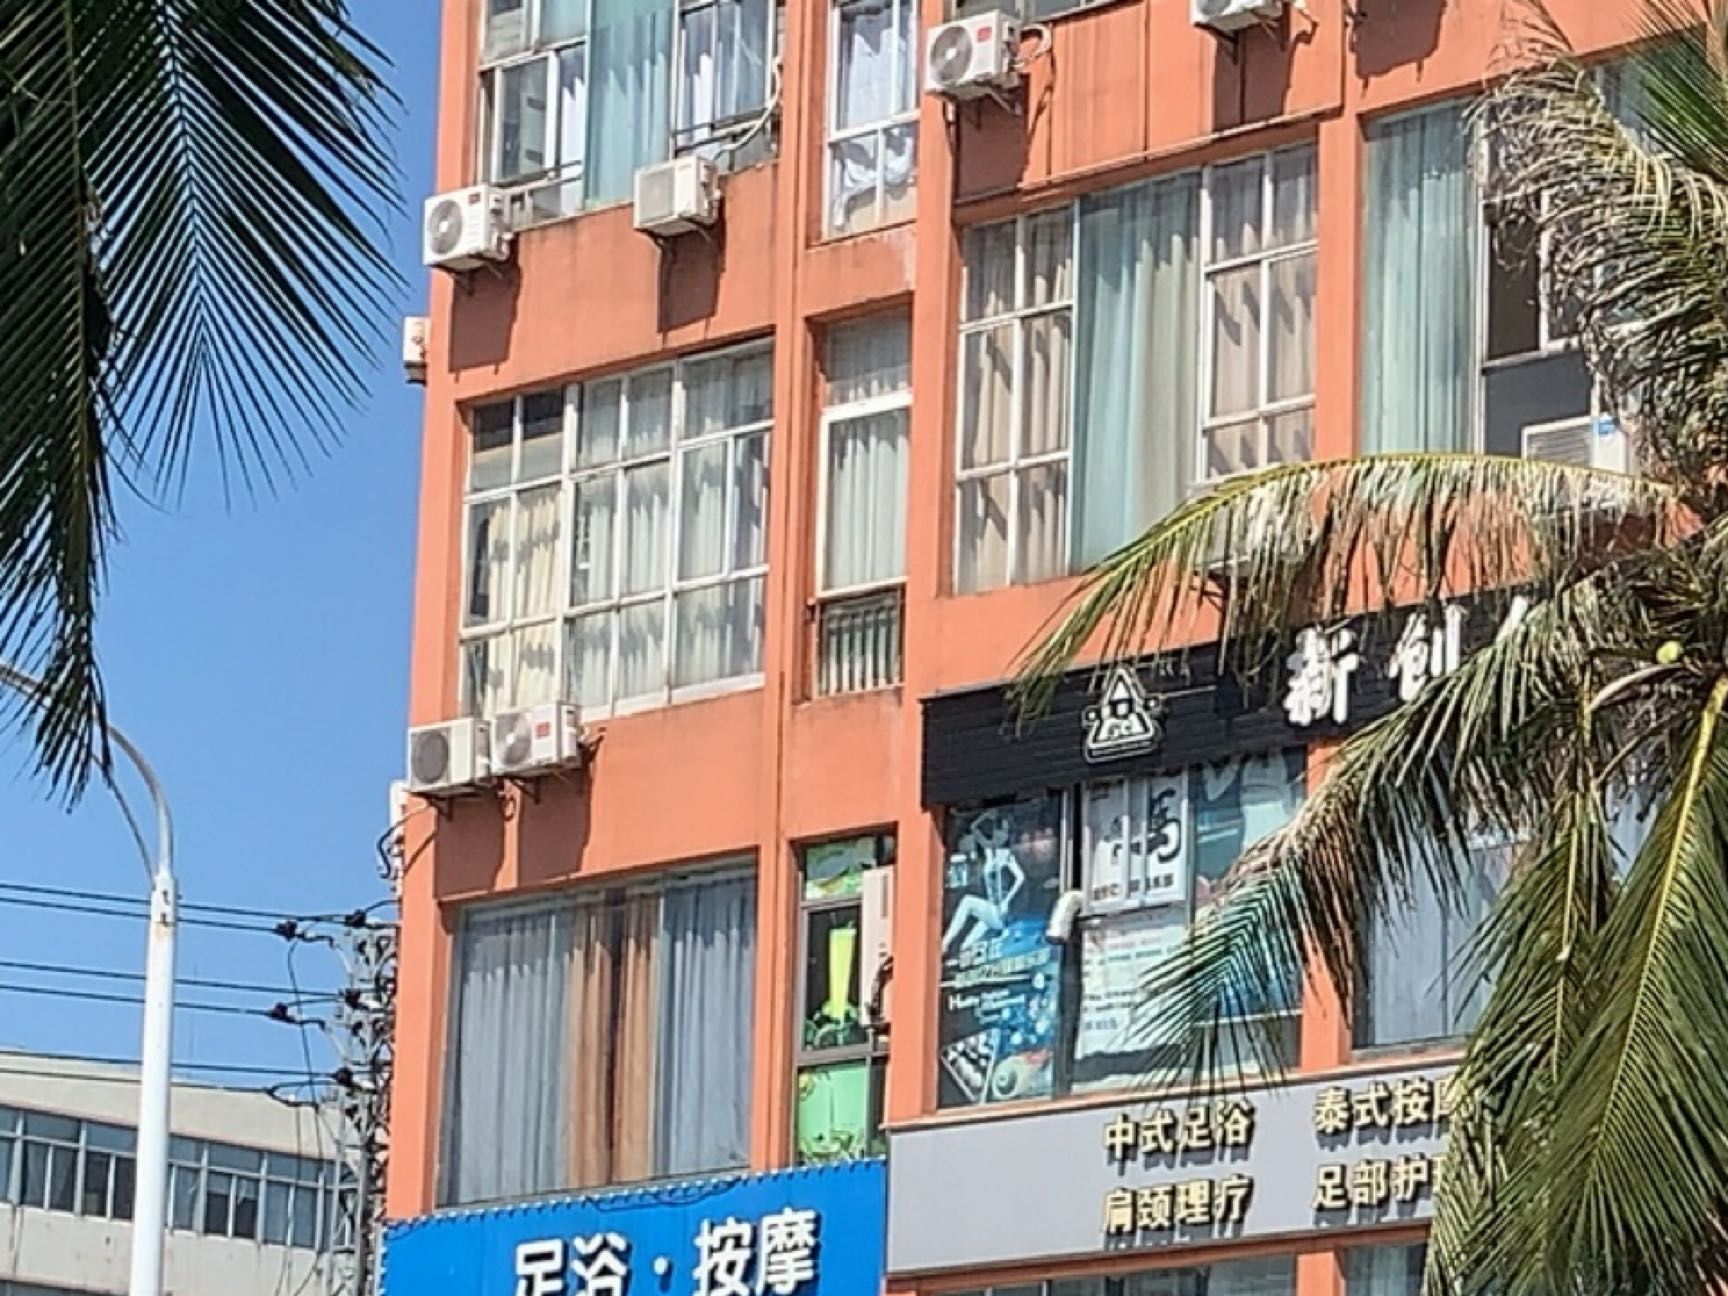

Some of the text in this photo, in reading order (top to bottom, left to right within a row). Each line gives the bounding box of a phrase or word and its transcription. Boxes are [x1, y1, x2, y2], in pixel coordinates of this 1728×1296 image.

[1104, 1101, 1256, 1157] 中式足浴
[1103, 1155, 1450, 1235] 肩颈理疗 足部护
